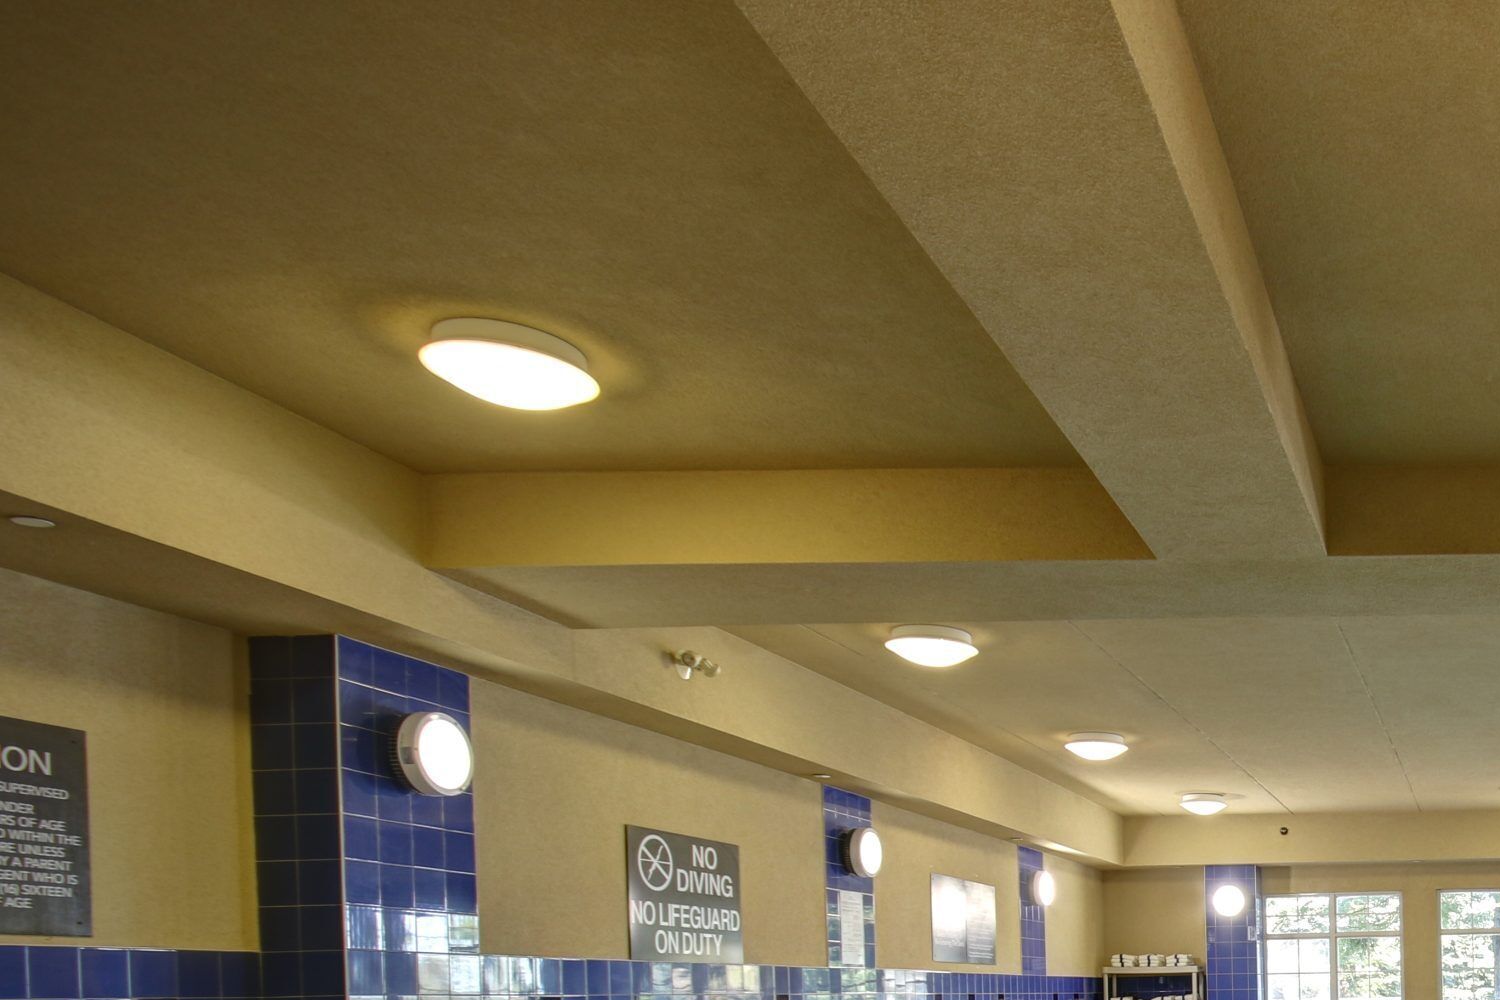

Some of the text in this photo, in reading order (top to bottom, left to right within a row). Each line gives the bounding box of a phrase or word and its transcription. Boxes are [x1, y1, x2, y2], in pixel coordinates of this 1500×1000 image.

[0, 745, 52, 776] ON
[17, 816, 38, 828] OF
[38, 819, 67, 832] AGE
[8, 829, 54, 844] WITHIN
[55, 833, 82, 846] THE
[17, 843, 66, 858] UNLESS
[692, 844, 717, 870] NO
[23, 857, 73, 872] PARENT
[32, 871, 65, 884] WHO
[67, 873, 79, 885] IS
[676, 868, 734, 898] DIVING
[21, 884, 73, 898] SIXTEEN
[4, 896, 33, 909] AGE
[630, 899, 740, 932] NO LIFEGUARD
[655, 929, 723, 956] ON DUTY
